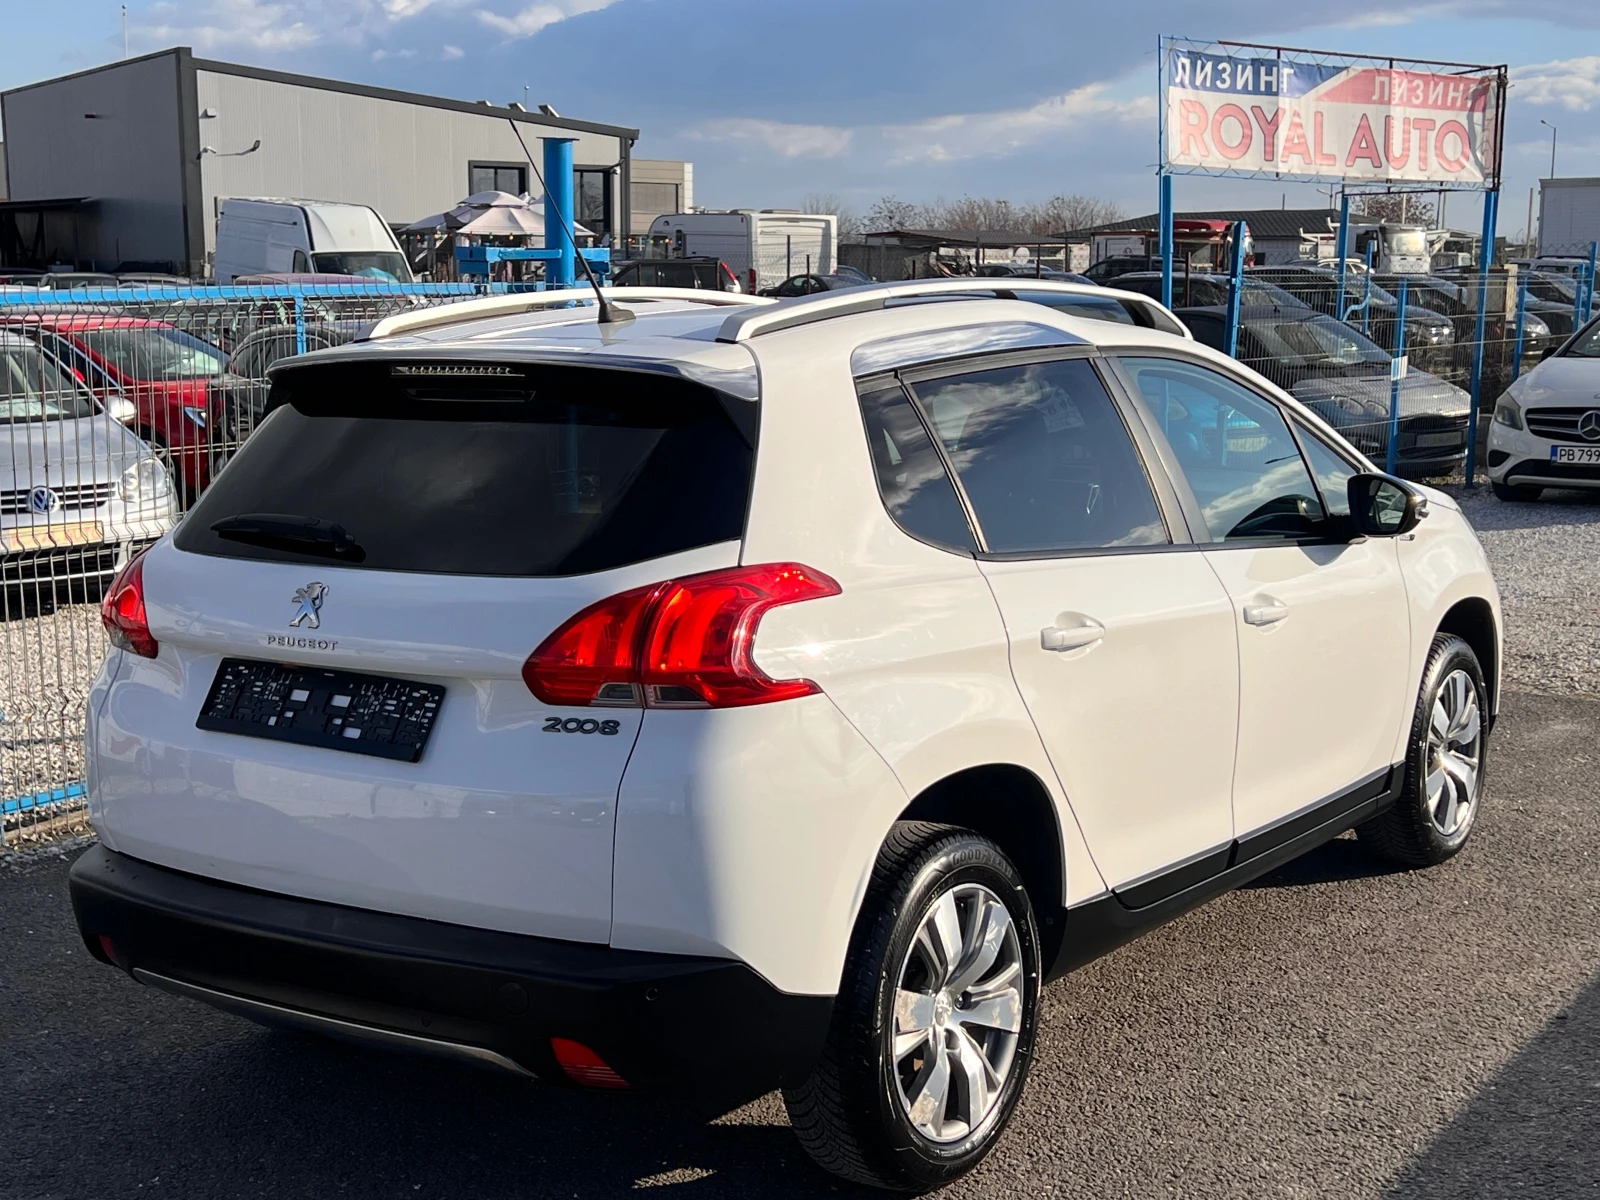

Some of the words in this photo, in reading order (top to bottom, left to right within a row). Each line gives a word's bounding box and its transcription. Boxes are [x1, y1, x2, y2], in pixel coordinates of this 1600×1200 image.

[1174, 57, 1295, 93] ЛИЗИНГ
[1179, 98, 1337, 166] ROYAL
[1345, 113, 1471, 173] AUTO
[1559, 448, 1575, 461] PB
[266, 635, 338, 650] PEUGEOT
[541, 716, 621, 736] 2008
